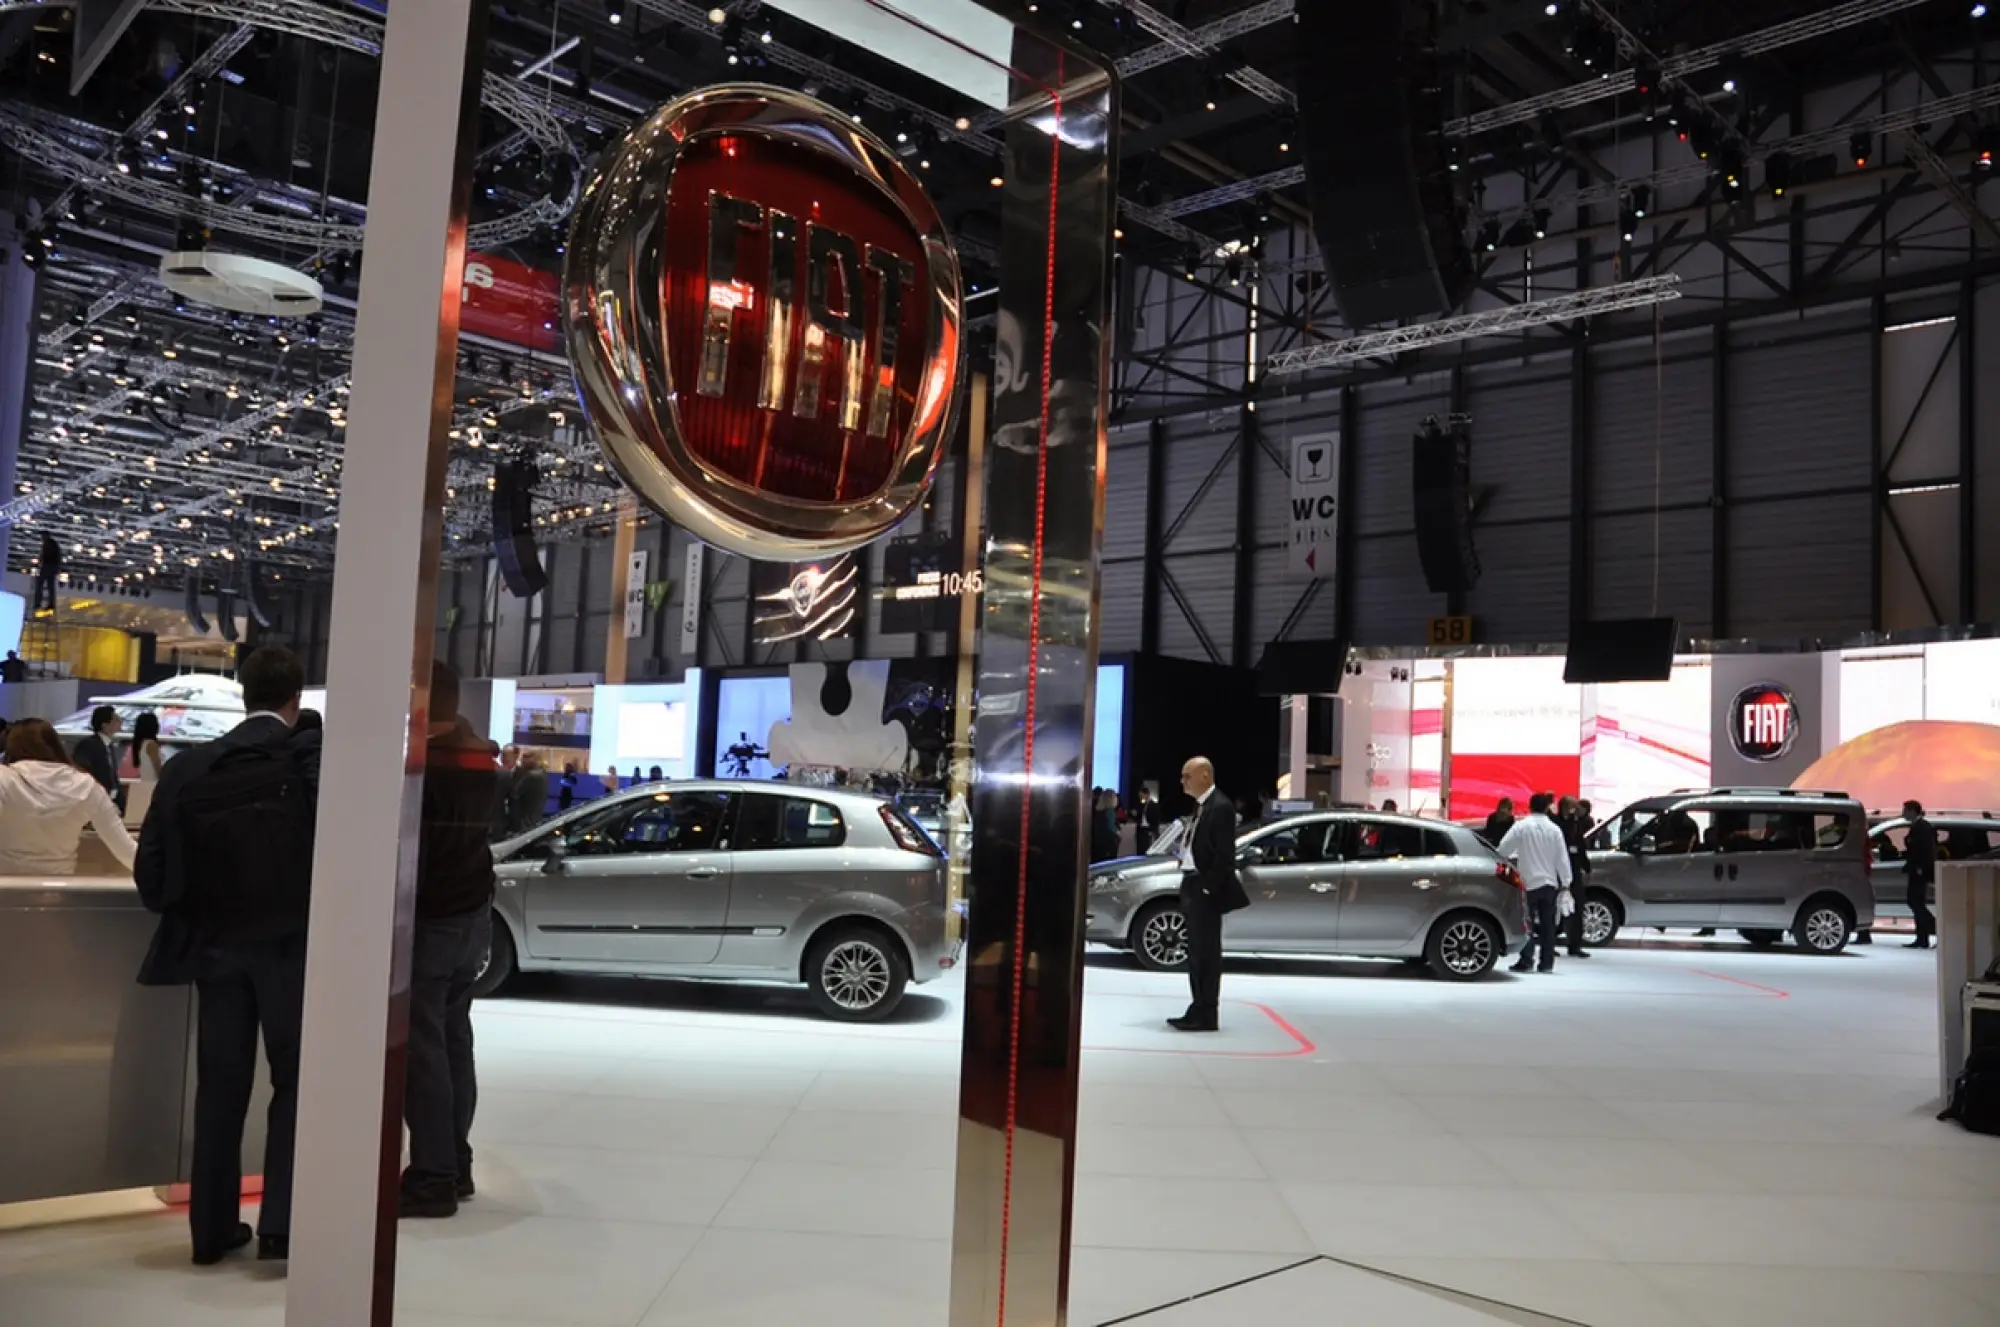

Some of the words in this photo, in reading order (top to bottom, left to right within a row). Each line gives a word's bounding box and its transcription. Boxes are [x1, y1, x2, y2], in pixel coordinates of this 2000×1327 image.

[697, 188, 914, 438] FIAT
[1292, 495, 1335, 521] WC
[942, 570, 982, 595] 10:45
[1433, 618, 1464, 642] 58
[1744, 703, 1789, 743] FIAT
